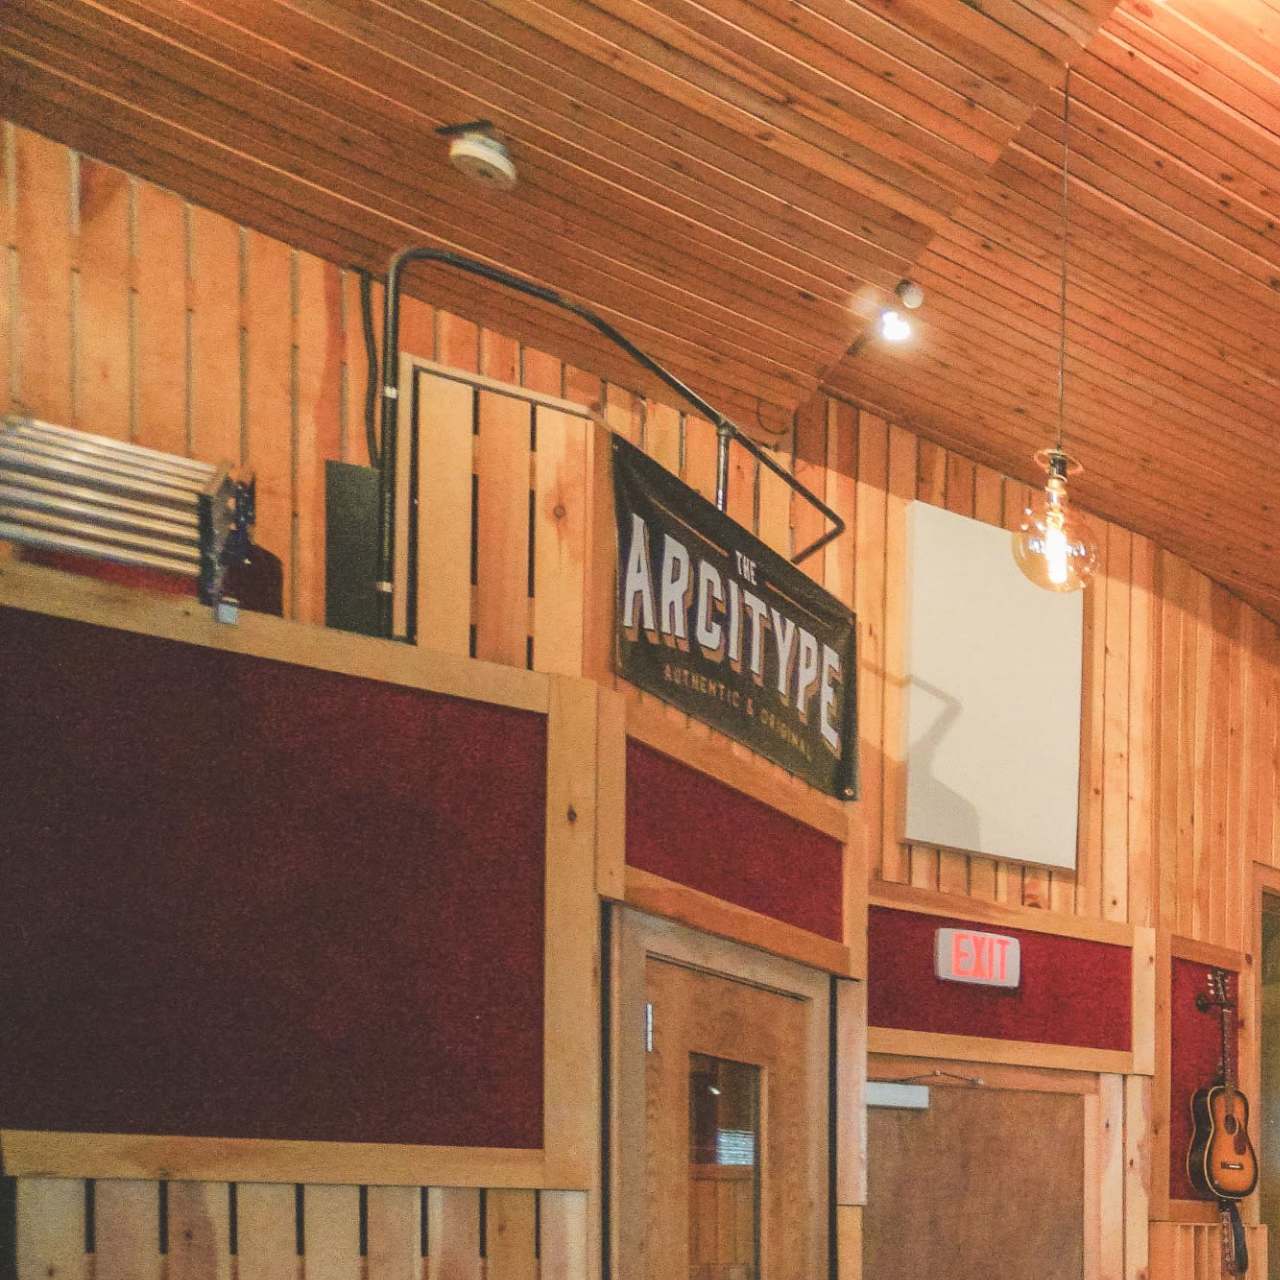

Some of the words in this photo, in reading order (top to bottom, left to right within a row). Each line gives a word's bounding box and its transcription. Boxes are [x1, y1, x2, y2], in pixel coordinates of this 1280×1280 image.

[735, 550, 758, 585] THE
[622, 512, 841, 754] ARCITYPE
[952, 932, 1012, 982] EXIT
